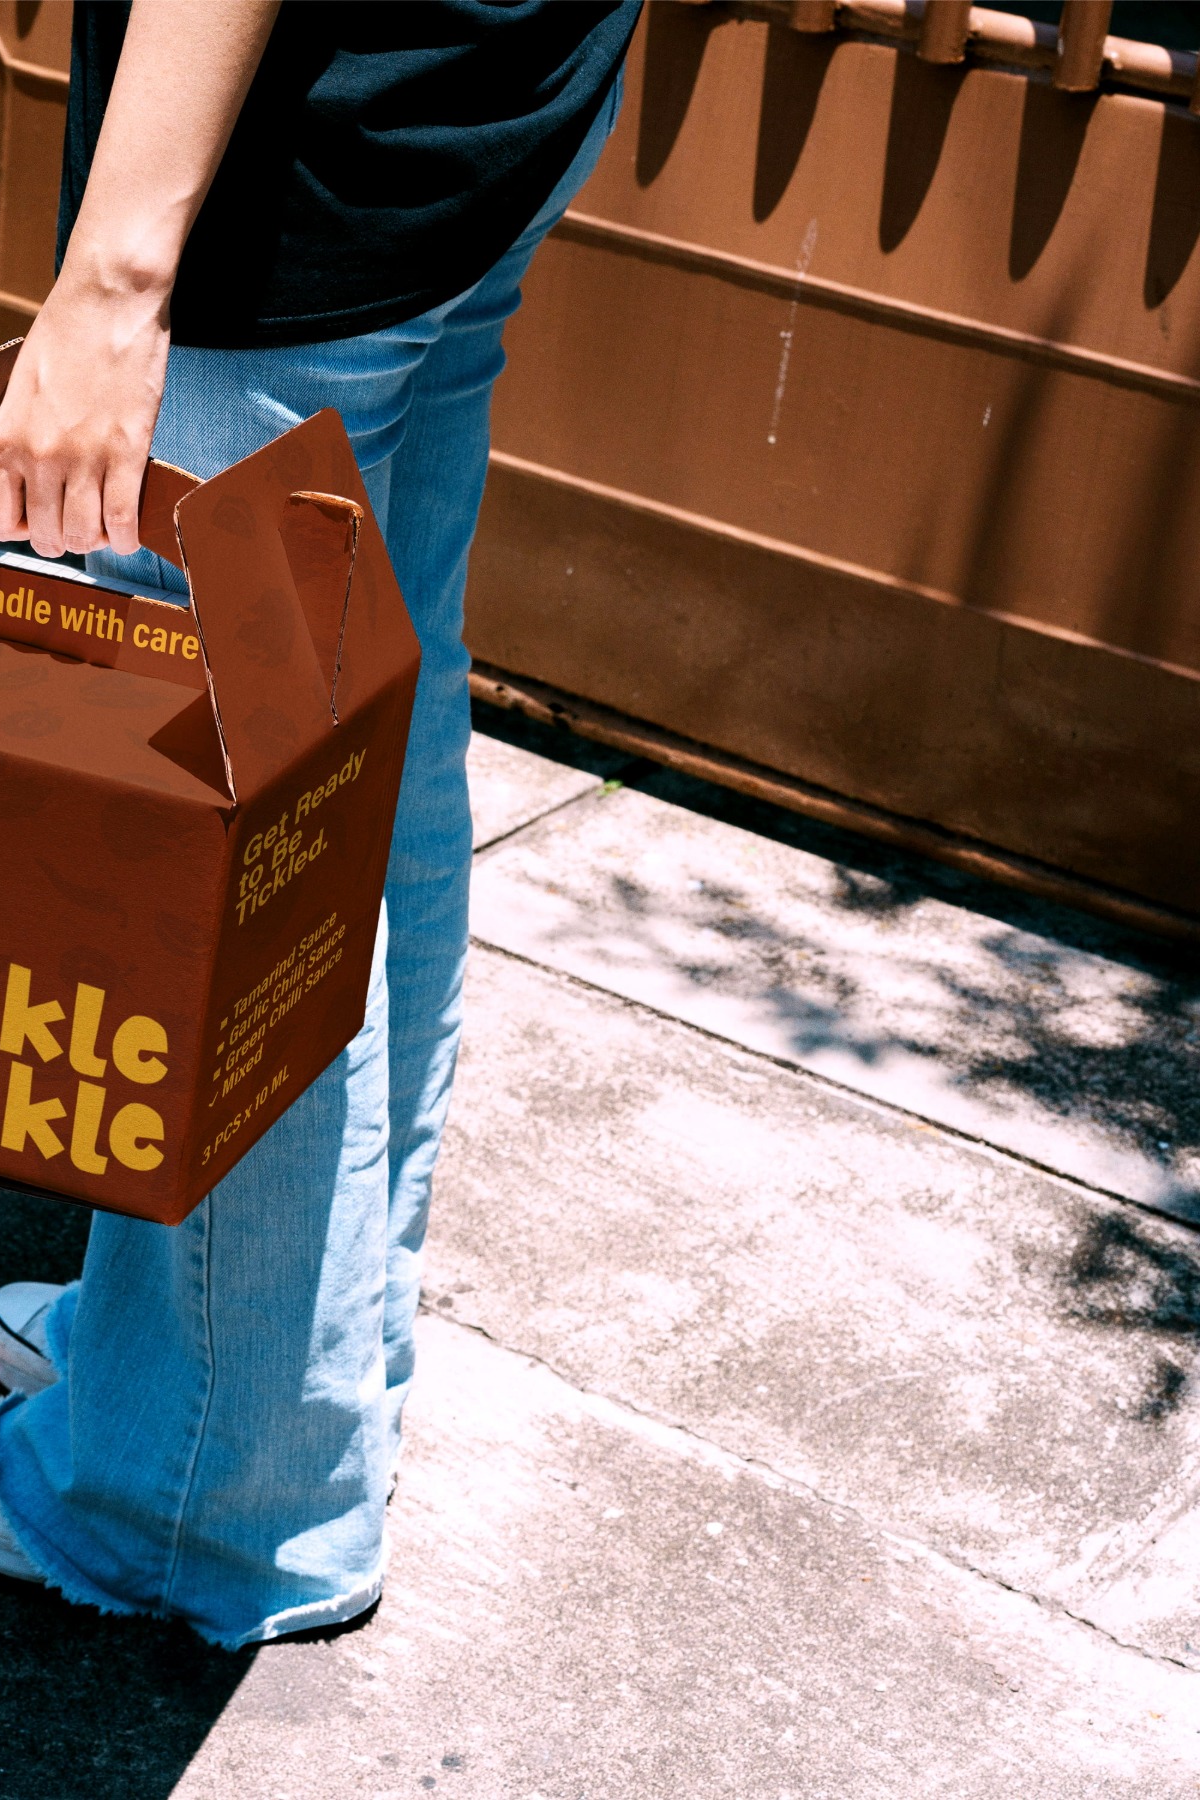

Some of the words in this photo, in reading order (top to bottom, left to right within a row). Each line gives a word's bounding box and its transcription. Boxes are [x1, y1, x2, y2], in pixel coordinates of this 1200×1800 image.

[60, 603, 125, 643] with
[132, 623, 200, 660] care
[243, 811, 290, 866] Get
[294, 747, 368, 825] Ready
[235, 827, 329, 927] Tickled.
[238, 863, 264, 899] to
[270, 829, 303, 872] Be
[225, 1022, 266, 1072] Green
[269, 985, 303, 1028] Chilli
[304, 947, 343, 993] Sauce
[229, 997, 270, 1047] Garlic
[272, 962, 306, 1004] Chilli
[307, 924, 346, 969] Sauce
[233, 945, 297, 1020] Tamarind
[298, 911, 337, 958] Sauce
[201, 1144, 211, 1166] 3
[213, 1112, 242, 1154] PCS
[243, 1103, 253, 1122] x
[254, 1085, 269, 1113] 10
[270, 1064, 290, 1095] ML
[221, 1042, 264, 1098] Mixed
